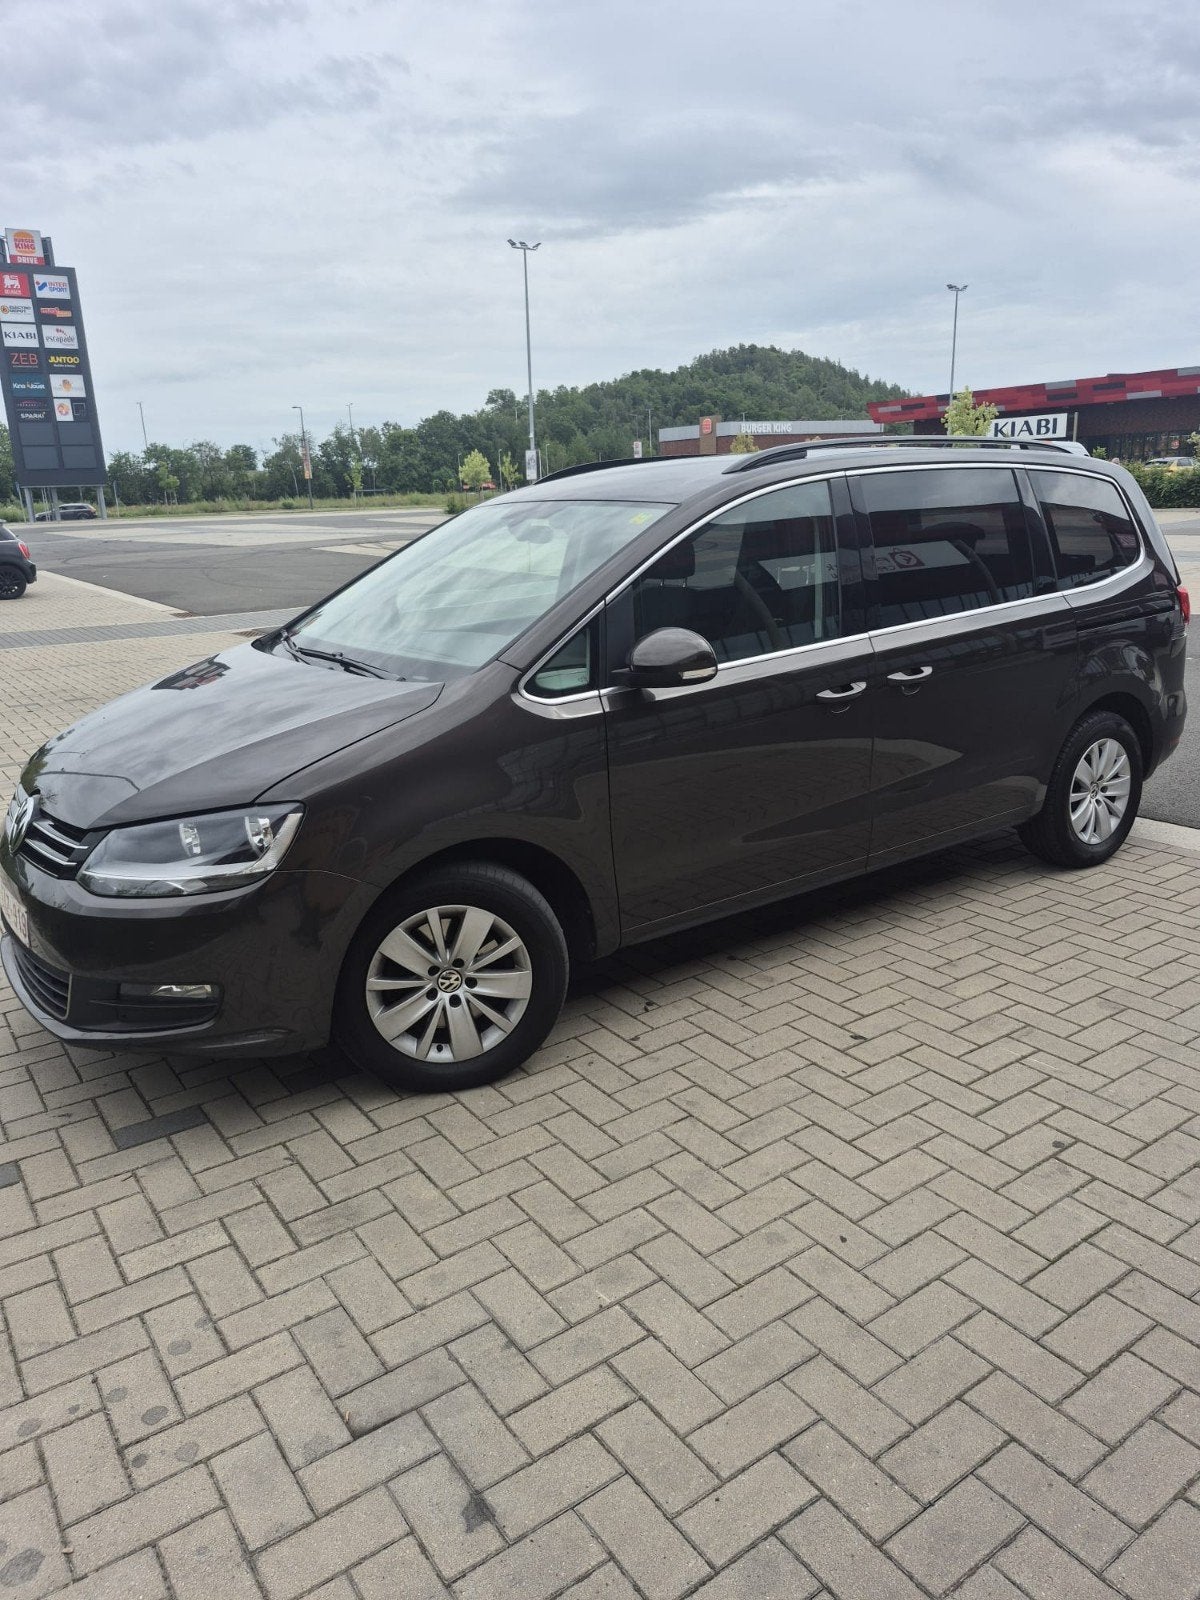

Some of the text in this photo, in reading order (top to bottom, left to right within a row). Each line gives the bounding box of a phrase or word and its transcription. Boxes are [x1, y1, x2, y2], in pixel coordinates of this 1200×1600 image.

[18, 256, 38, 264] DRIVE
[4, 332, 37, 340] KIABI
[10, 353, 38, 365] ZEB
[741, 423, 792, 433] BURGER KING
[993, 417, 1058, 438] KIABI
